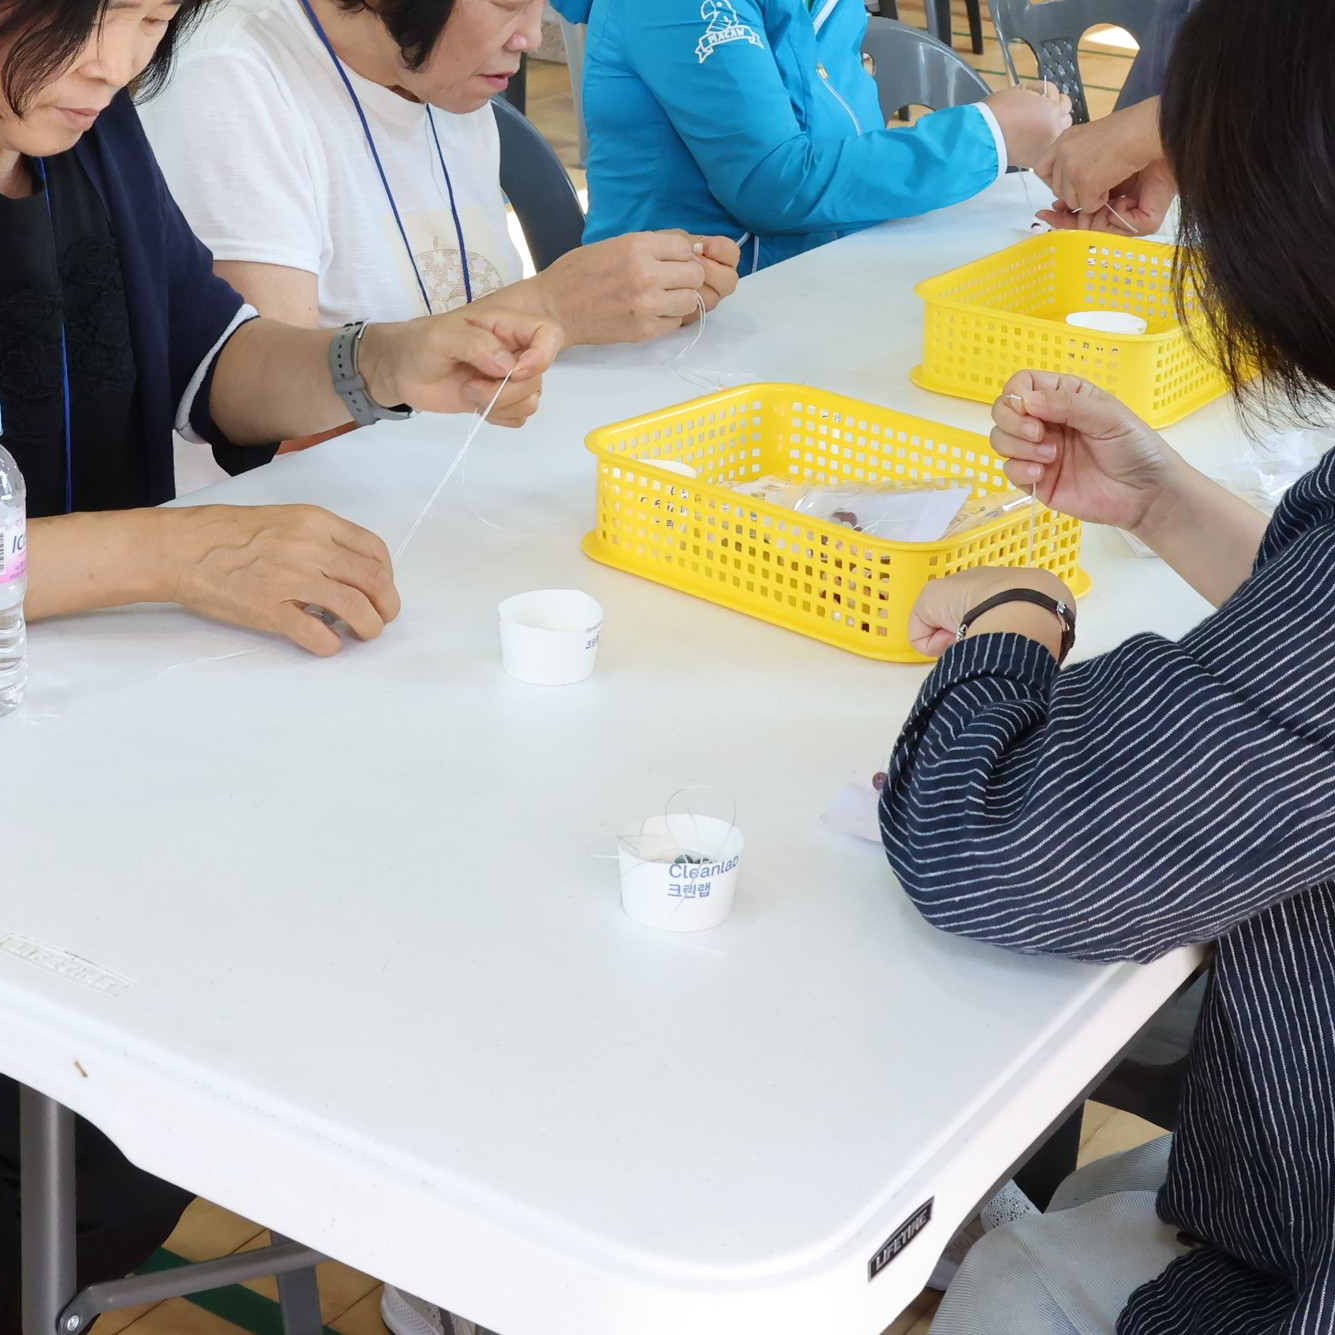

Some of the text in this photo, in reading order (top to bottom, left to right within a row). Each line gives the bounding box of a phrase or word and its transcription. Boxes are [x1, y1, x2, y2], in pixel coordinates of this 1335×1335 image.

[708, 28, 745, 44] MACAW
[667, 881, 711, 899] 크린랩
[875, 1207, 928, 1271] LIFETIME
